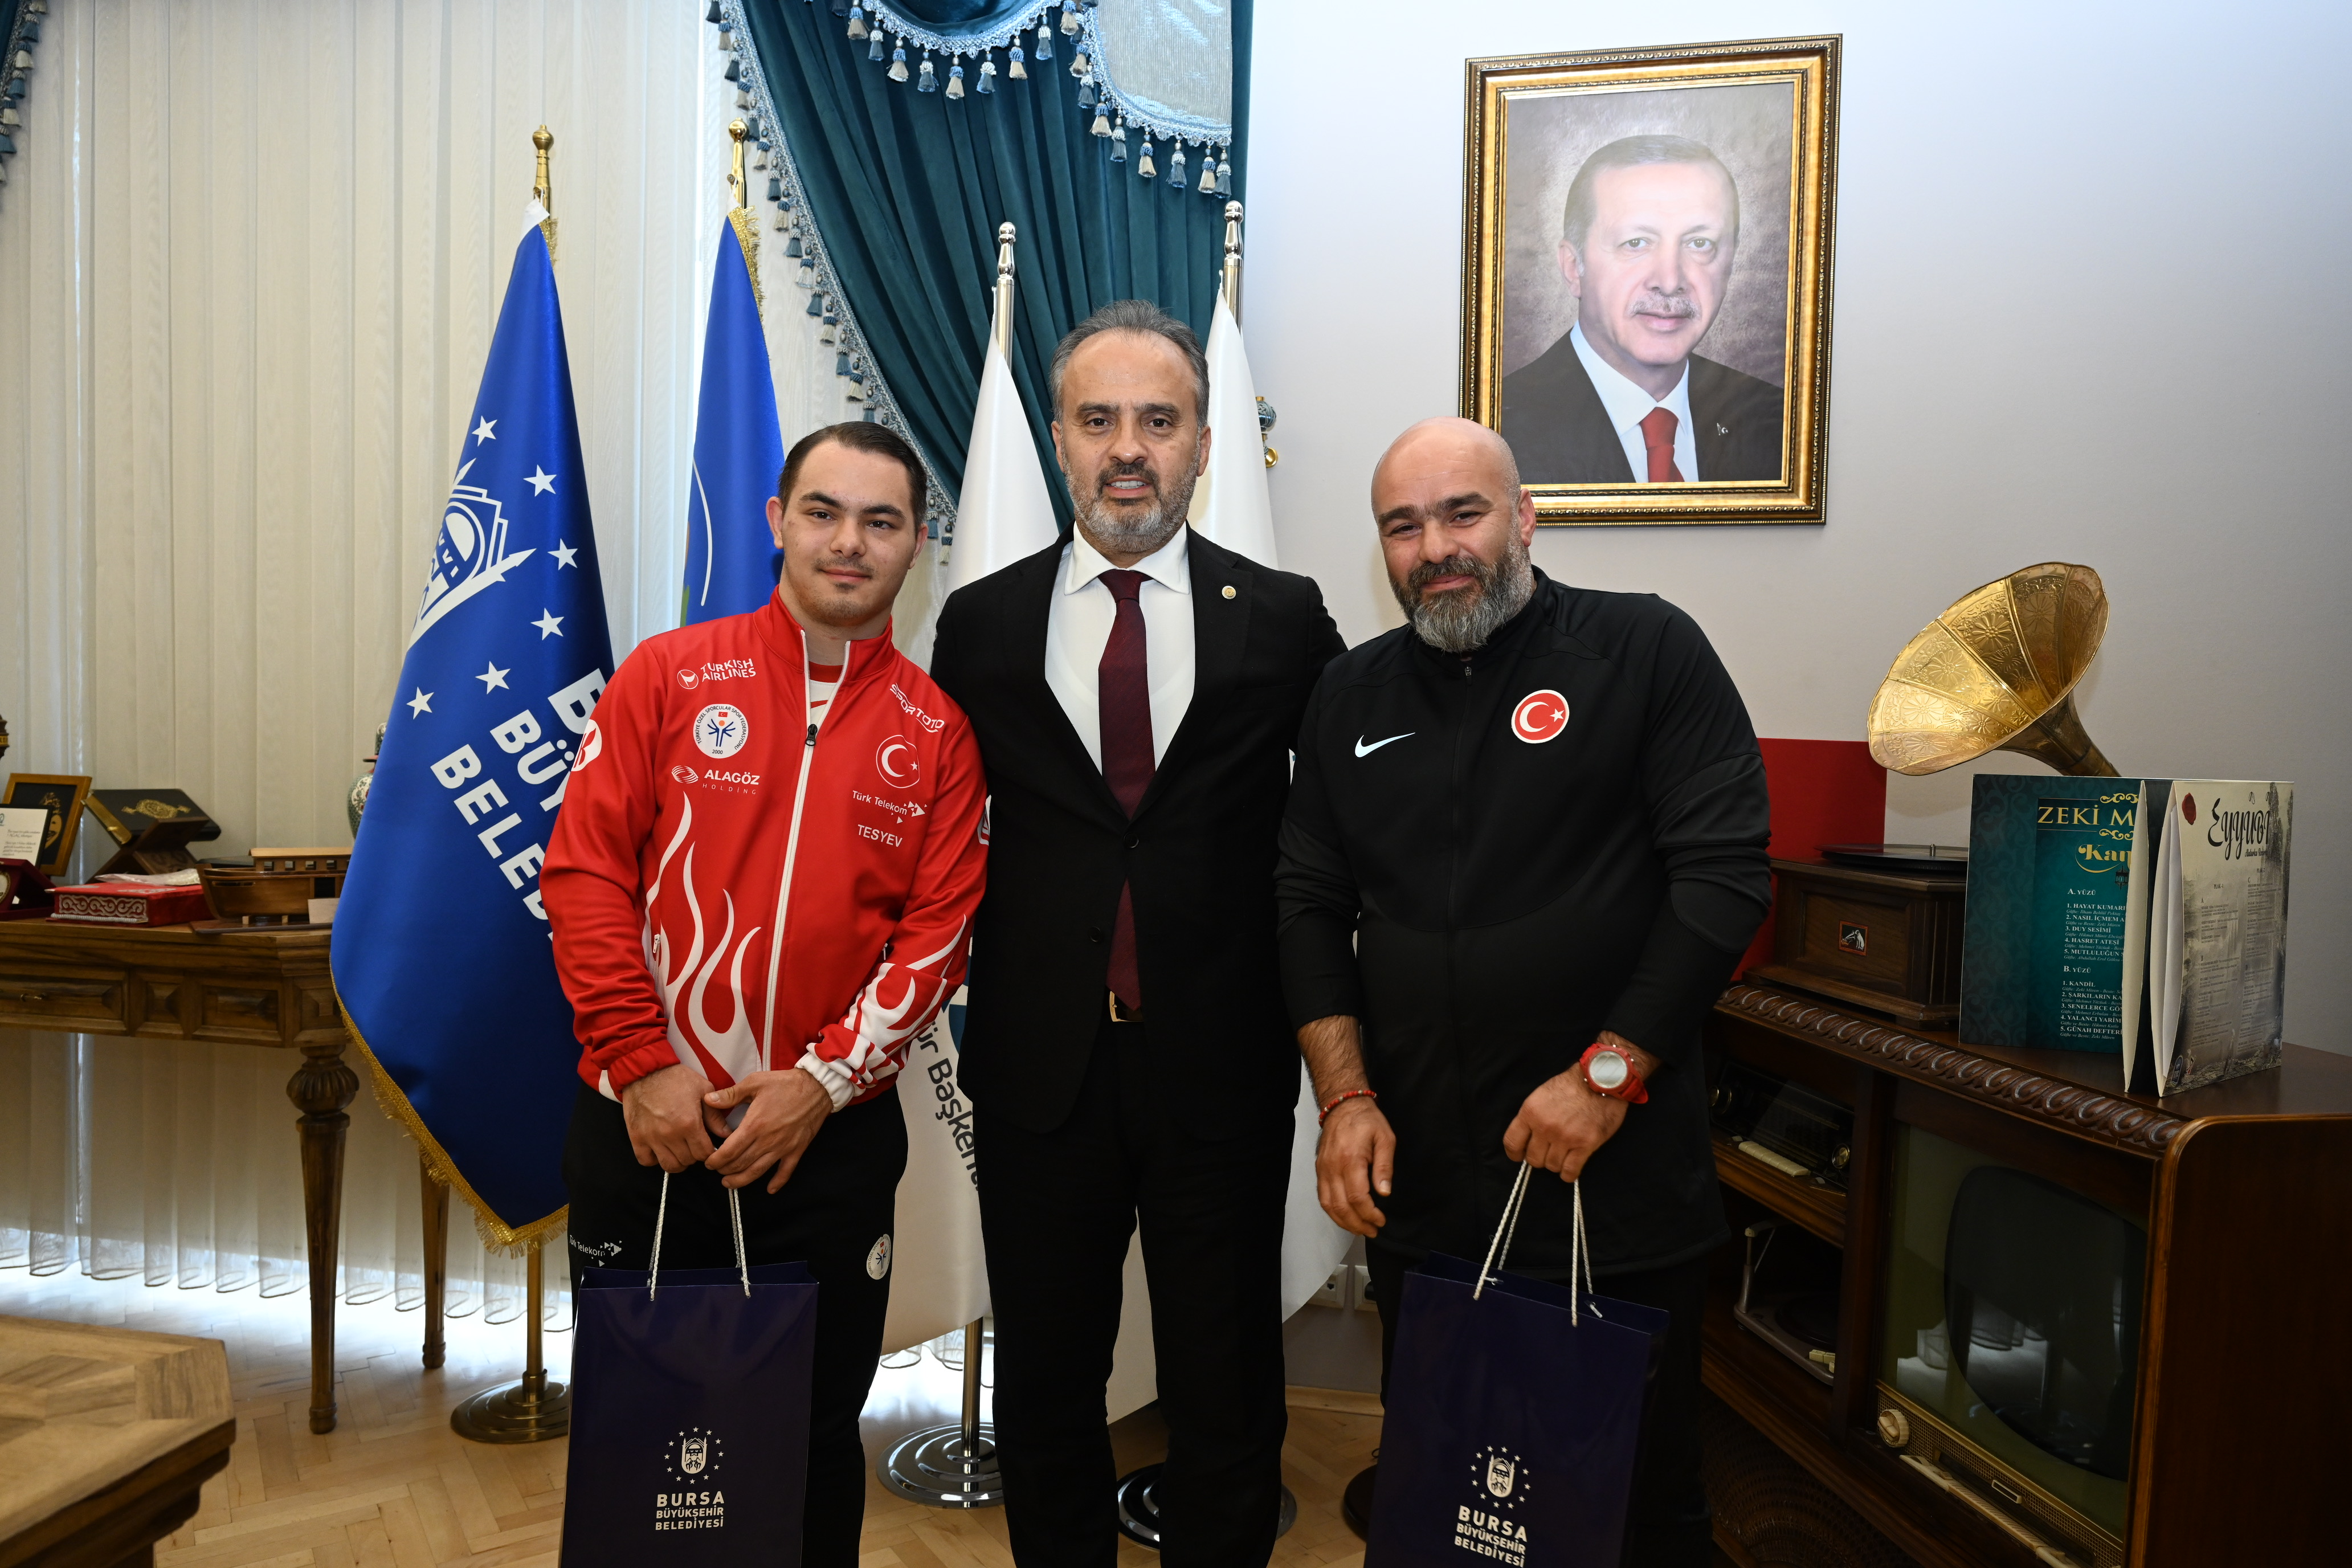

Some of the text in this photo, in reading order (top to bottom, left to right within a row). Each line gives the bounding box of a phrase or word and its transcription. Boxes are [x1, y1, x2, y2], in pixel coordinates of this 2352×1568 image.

[700, 658, 753, 673] TURKISH
[701, 667, 756, 683] AIRLINES
[548, 668, 607, 734] B
[697, 712, 707, 724] ÖZEL
[731, 708, 742, 718] SPOR
[734, 718, 746, 750] FEDERASYONU
[704, 769, 761, 786] ALAGÖZ
[703, 783, 756, 795] HOLDİNG
[852, 790, 908, 815] Türk Telekom
[2037, 805, 2135, 826] ZEKİ M
[430, 744, 553, 940] BELED
[858, 824, 903, 847] TESYEV
[2077, 843, 2132, 871] Kan
[577, 1242, 605, 1257] Telekom
[657, 1491, 724, 1507] BURSA
[656, 1505, 724, 1519] BÜYÜKŞEHİR
[655, 1516, 724, 1530] BELEDİYESİ
[1458, 1505, 1528, 1542] BURSA
[1456, 1522, 1526, 1555] BÜYÜKŞEHİR
[1454, 1535, 1525, 1567] BELEDİYESİ
